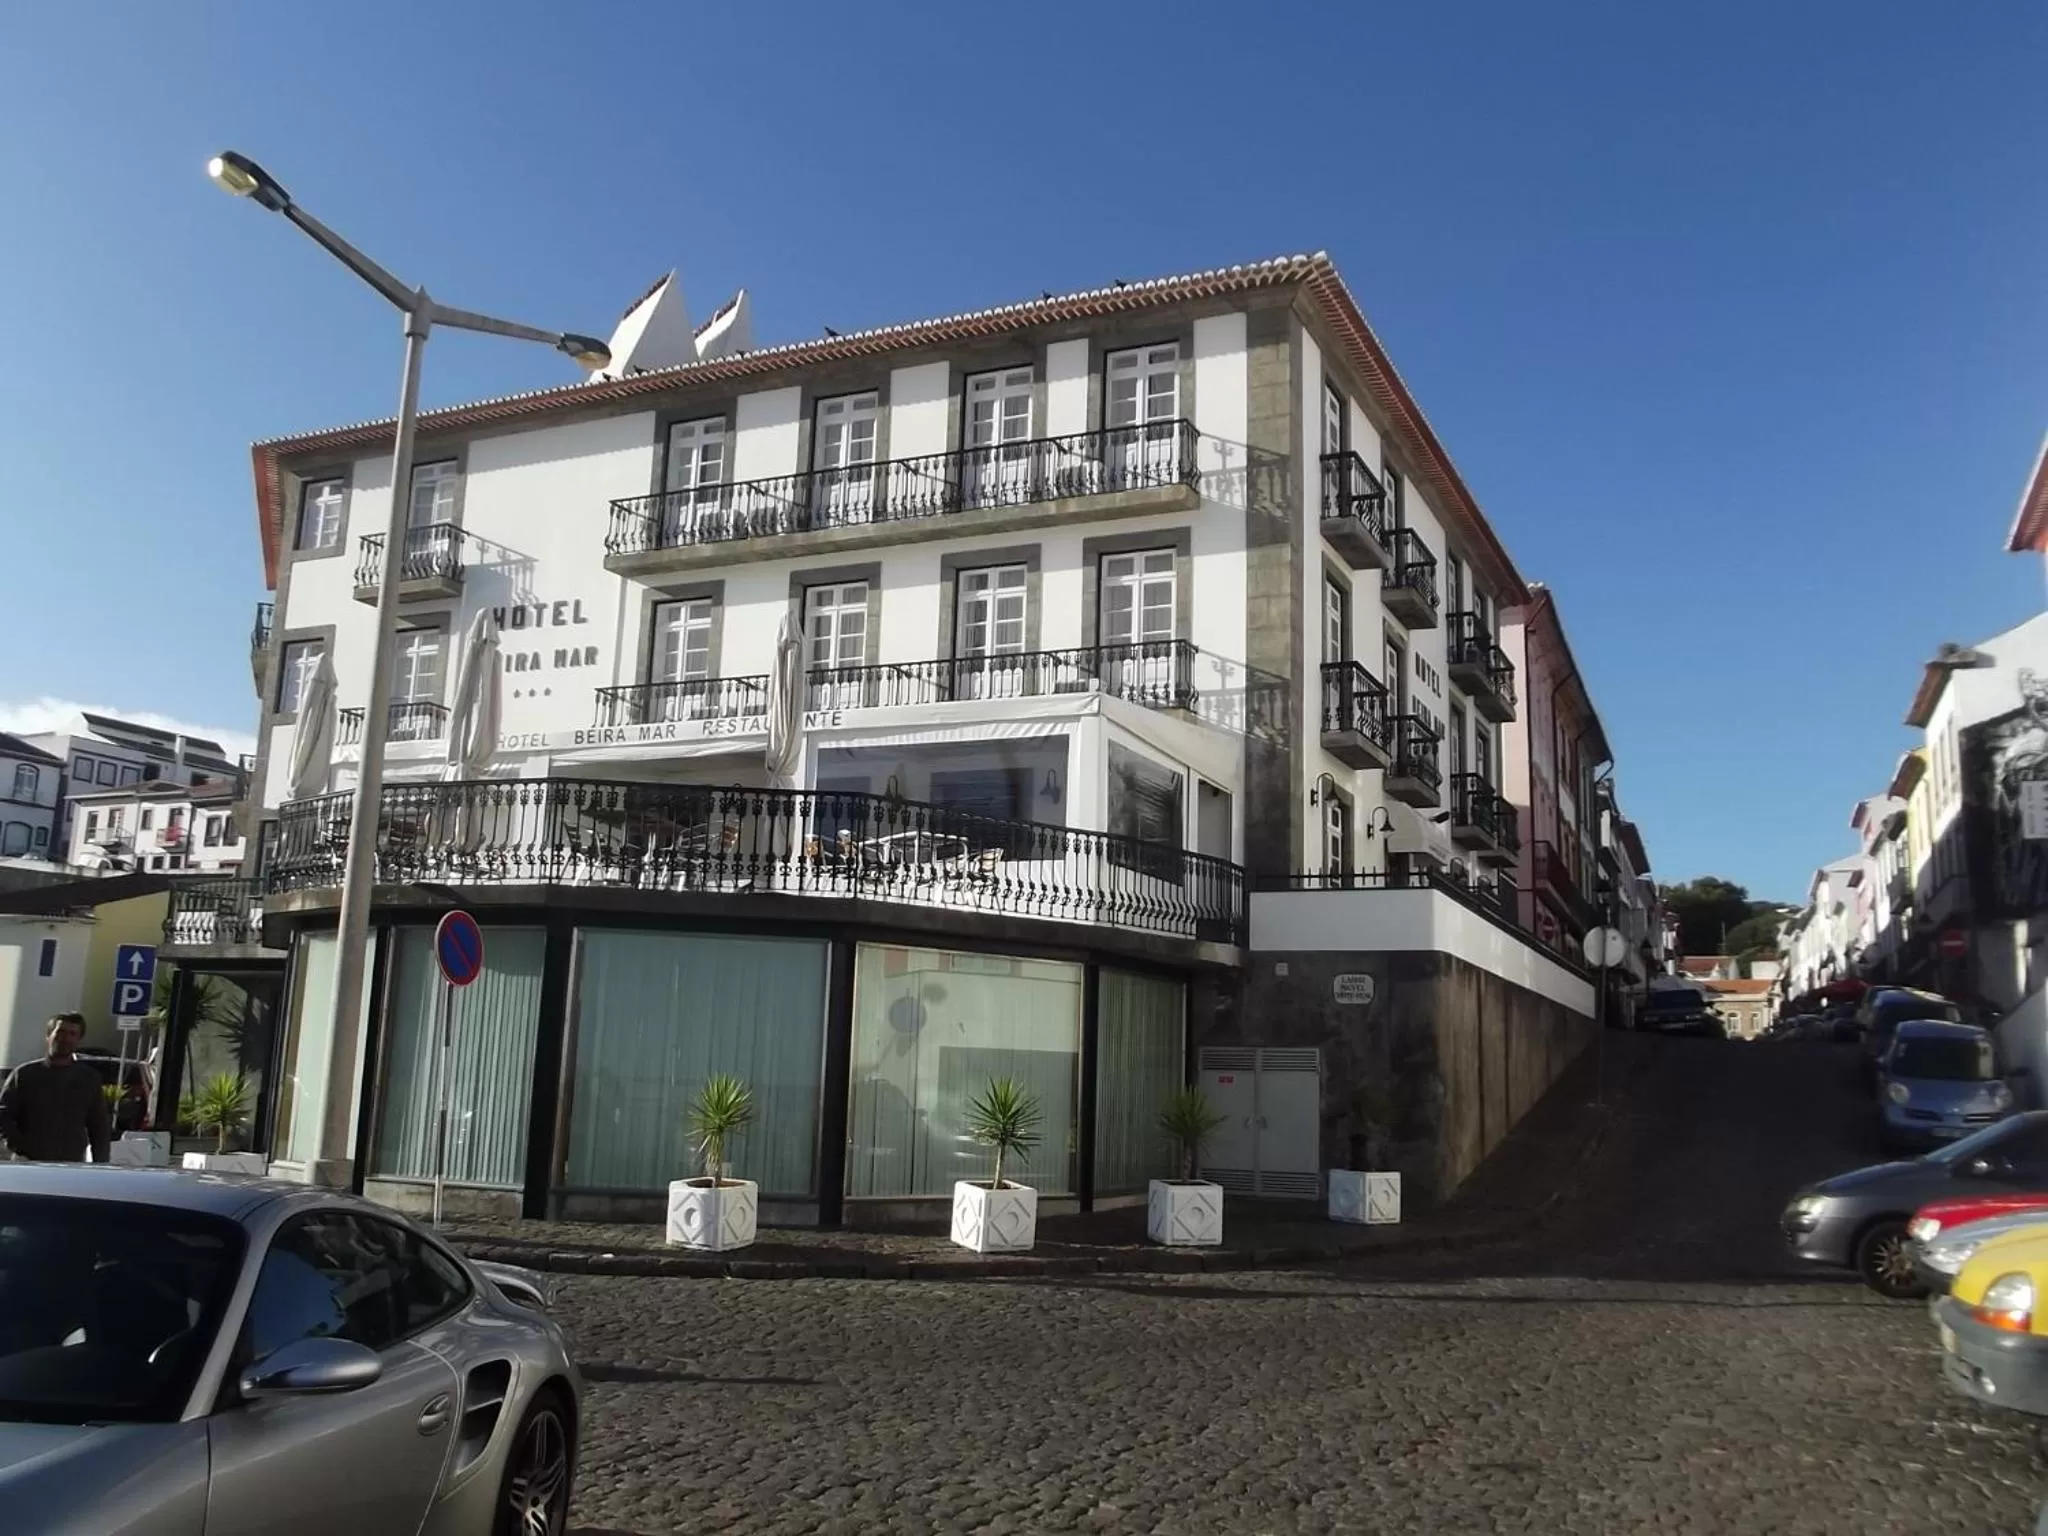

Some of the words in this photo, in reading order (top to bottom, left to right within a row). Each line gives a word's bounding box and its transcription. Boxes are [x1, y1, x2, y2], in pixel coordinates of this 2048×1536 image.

[493, 598, 589, 631] HOTEL
[503, 651, 542, 673] IRA
[554, 645, 599, 669] MAR
[1415, 651, 1442, 698] HOTEL
[574, 727, 626, 745] BEIRA
[638, 724, 676, 741] MAR
[119, 983, 144, 1013] P
